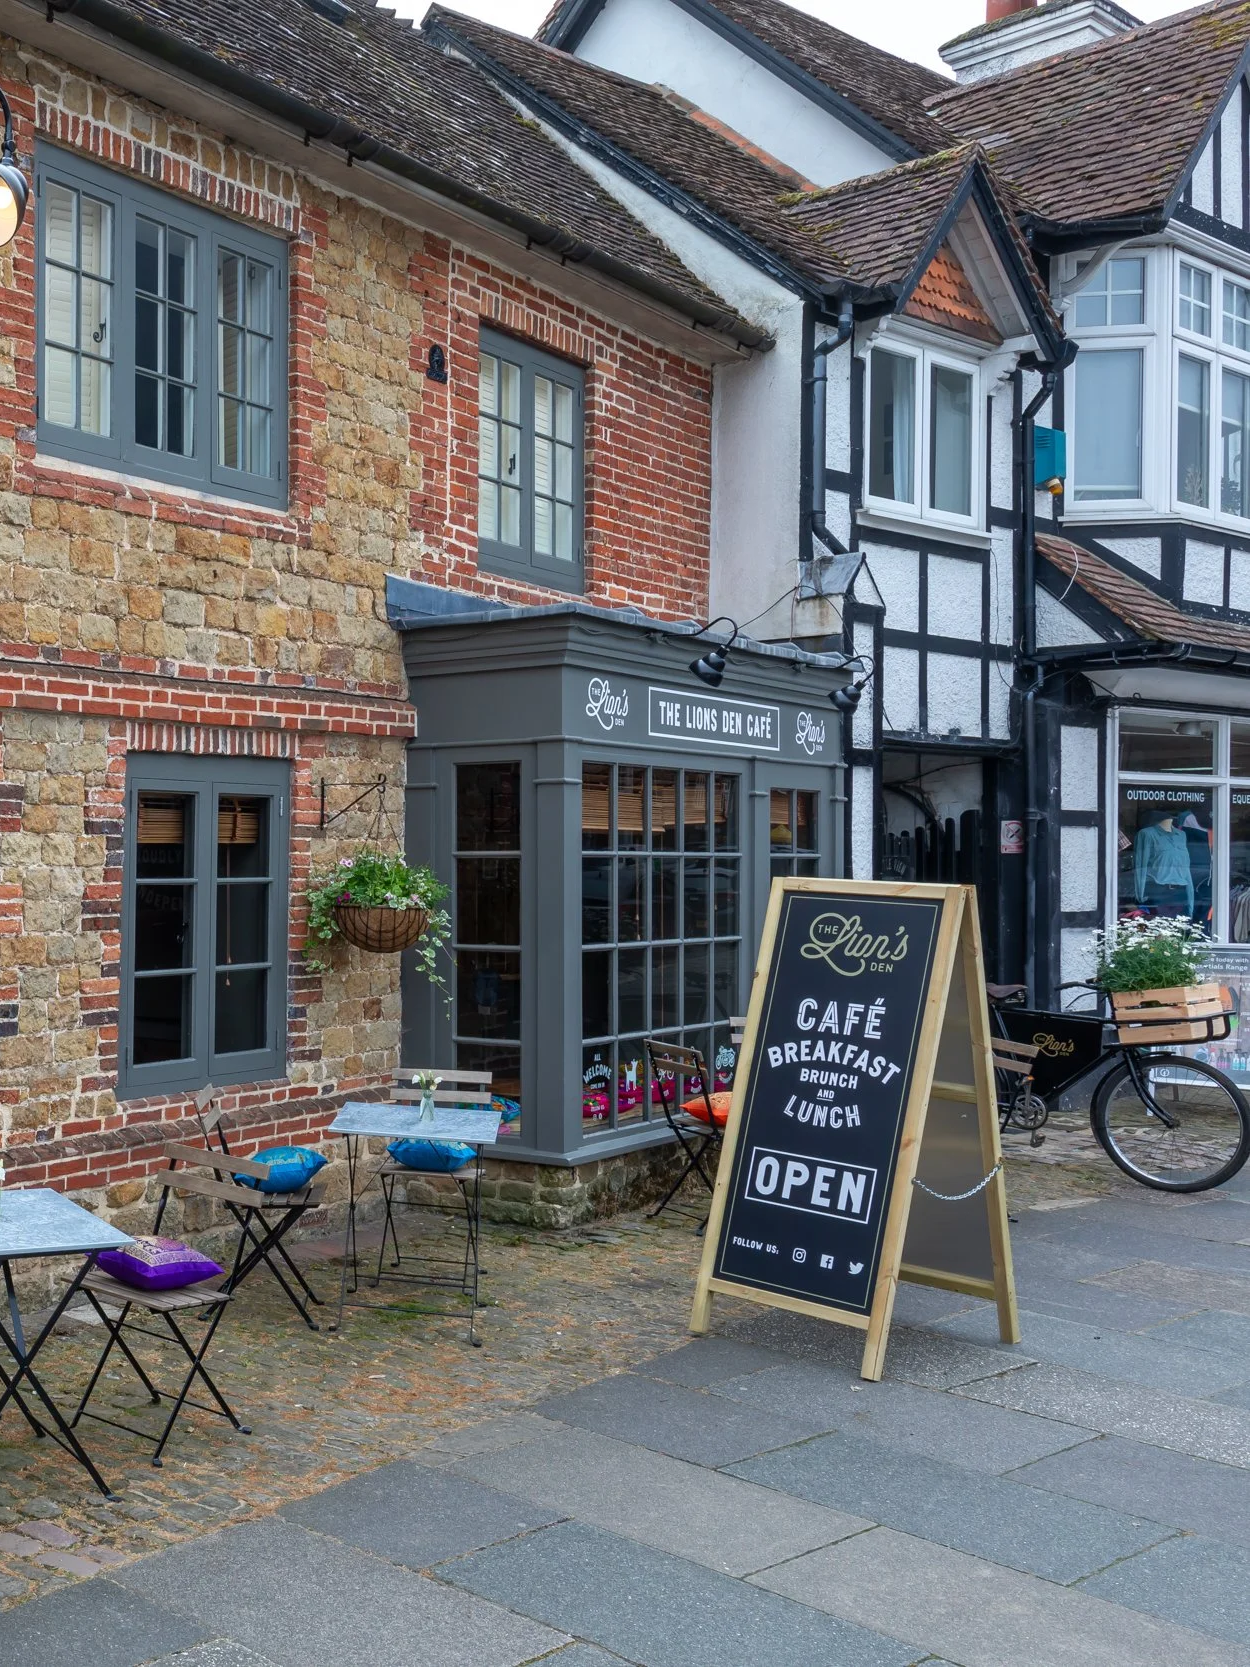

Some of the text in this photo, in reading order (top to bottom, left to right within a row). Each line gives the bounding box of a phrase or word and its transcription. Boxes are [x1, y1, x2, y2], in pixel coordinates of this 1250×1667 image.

[591, 687, 601, 696] THE
[585, 677, 629, 731] Lion's
[614, 718, 625, 727] DEN
[659, 701, 772, 739] THE LIONS DEN CAFÉ
[815, 744, 823, 752] DEN
[1127, 790, 1205, 803] OUTDOOR CLOTHING
[817, 924, 839, 935] THE
[800, 912, 909, 977] Lion's
[870, 963, 894, 973] DEN
[1226, 964, 1248, 972] Range
[797, 998, 886, 1039] CAFÉ
[593, 1053, 601, 1061] ALL
[768, 1040, 901, 1085] BREAKFAST
[583, 1064, 612, 1084] WELCOME
[800, 1068, 858, 1089] BRUNCH
[817, 1089, 835, 1099] AND
[783, 1095, 861, 1128] LUNCH
[755, 1156, 867, 1214] OPEN
[733, 1236, 763, 1250] FOLLOW
